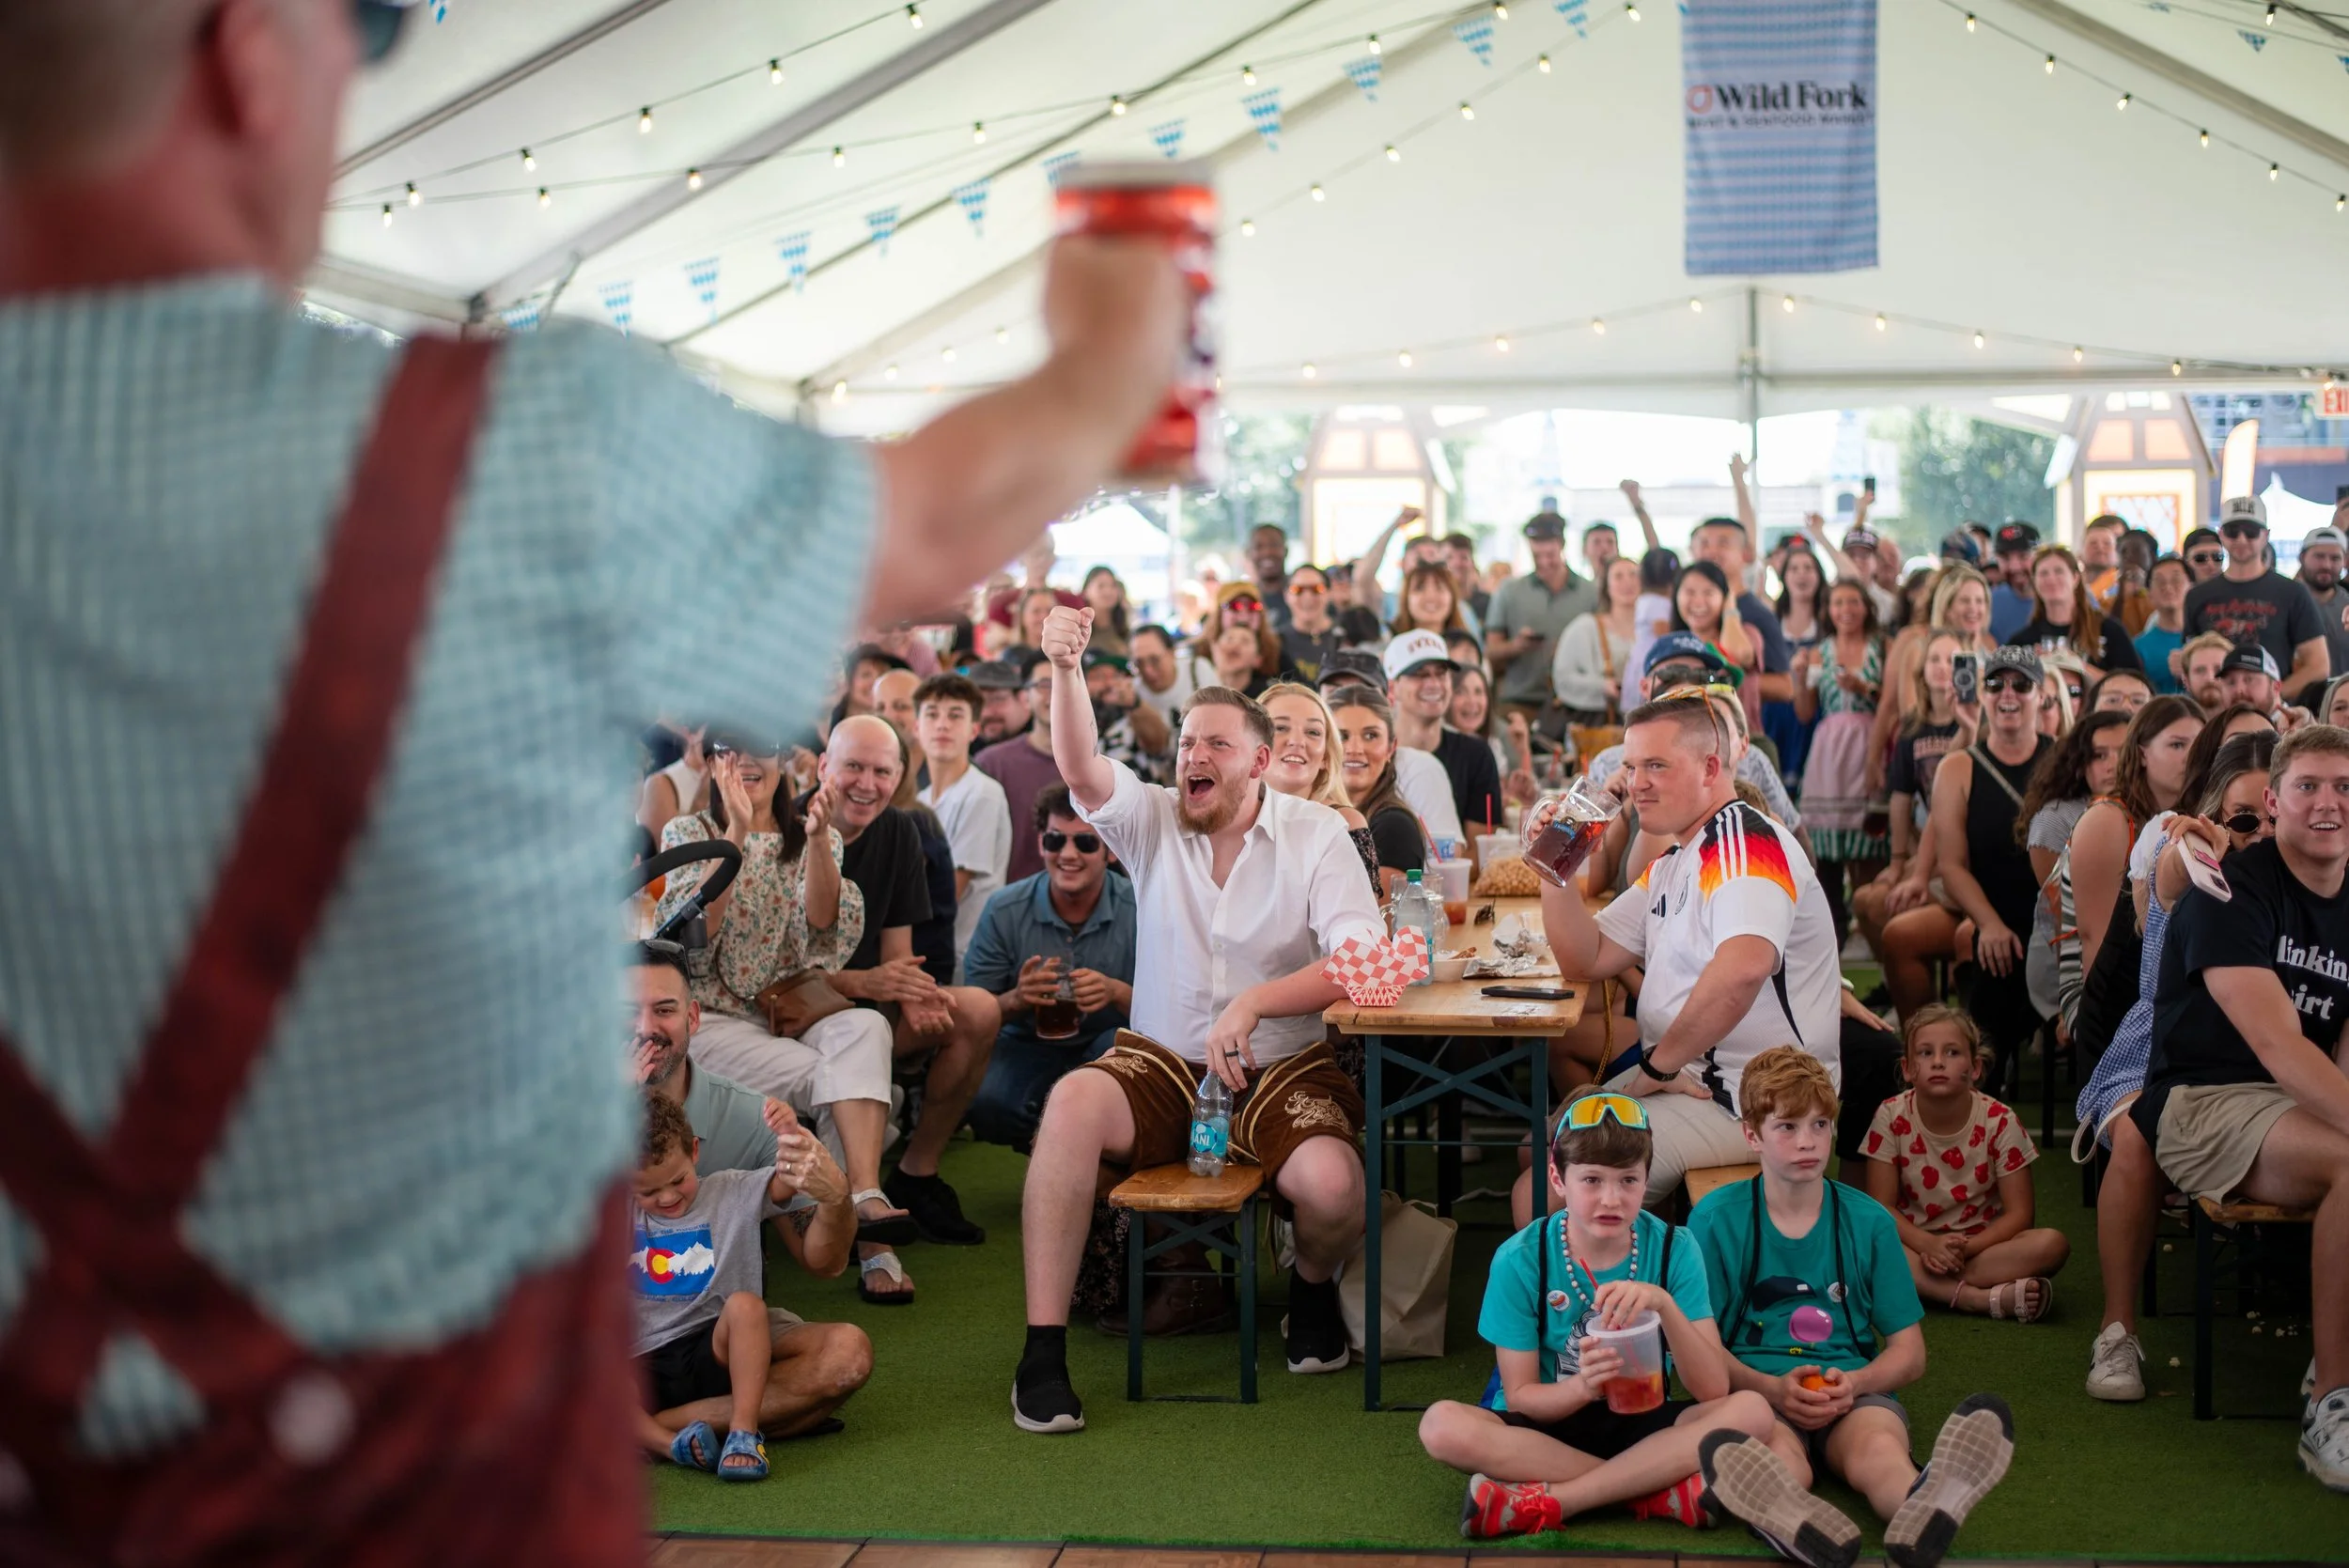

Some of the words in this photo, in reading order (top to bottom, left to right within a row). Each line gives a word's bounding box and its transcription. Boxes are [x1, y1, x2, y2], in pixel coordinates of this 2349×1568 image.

[1714, 82, 1790, 112] Wild
[1796, 80, 1867, 110] Fork
[2325, 387, 2349, 414] EXI
[2277, 935, 2349, 987] linkin
[2292, 984, 2334, 1020] irt
[1194, 1133, 1210, 1146] ANI
